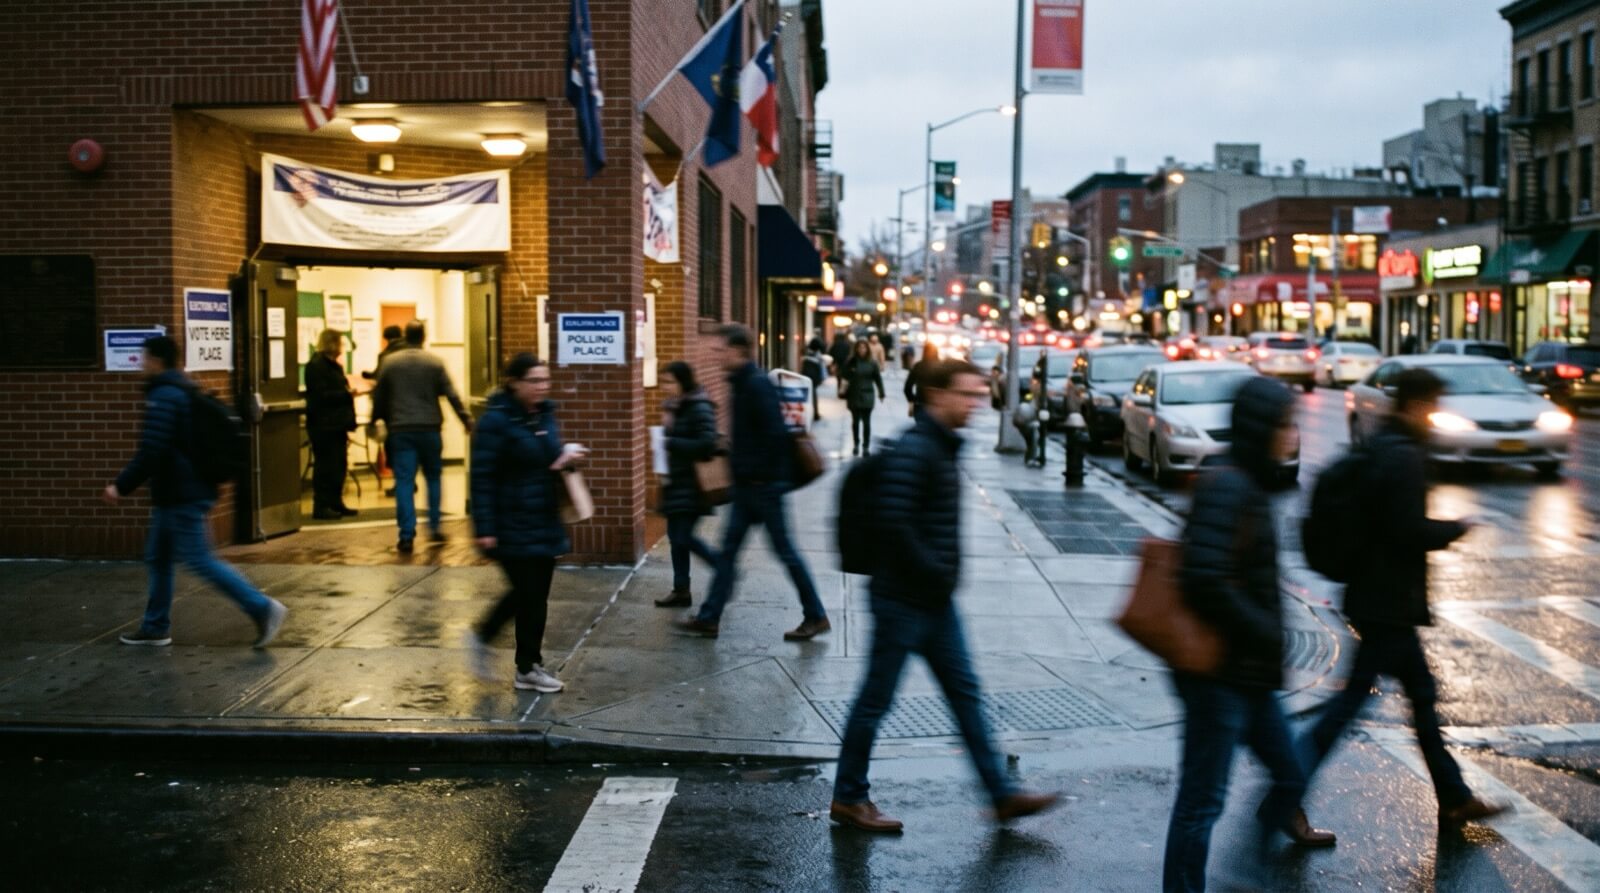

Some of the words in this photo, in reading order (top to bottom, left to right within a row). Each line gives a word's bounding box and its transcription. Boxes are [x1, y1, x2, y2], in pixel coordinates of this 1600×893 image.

[188, 327, 209, 341] VOTE
[211, 327, 230, 341] HERE
[567, 335, 614, 344] POLLING
[199, 347, 222, 361] PLACE
[573, 347, 608, 356] PLACE
